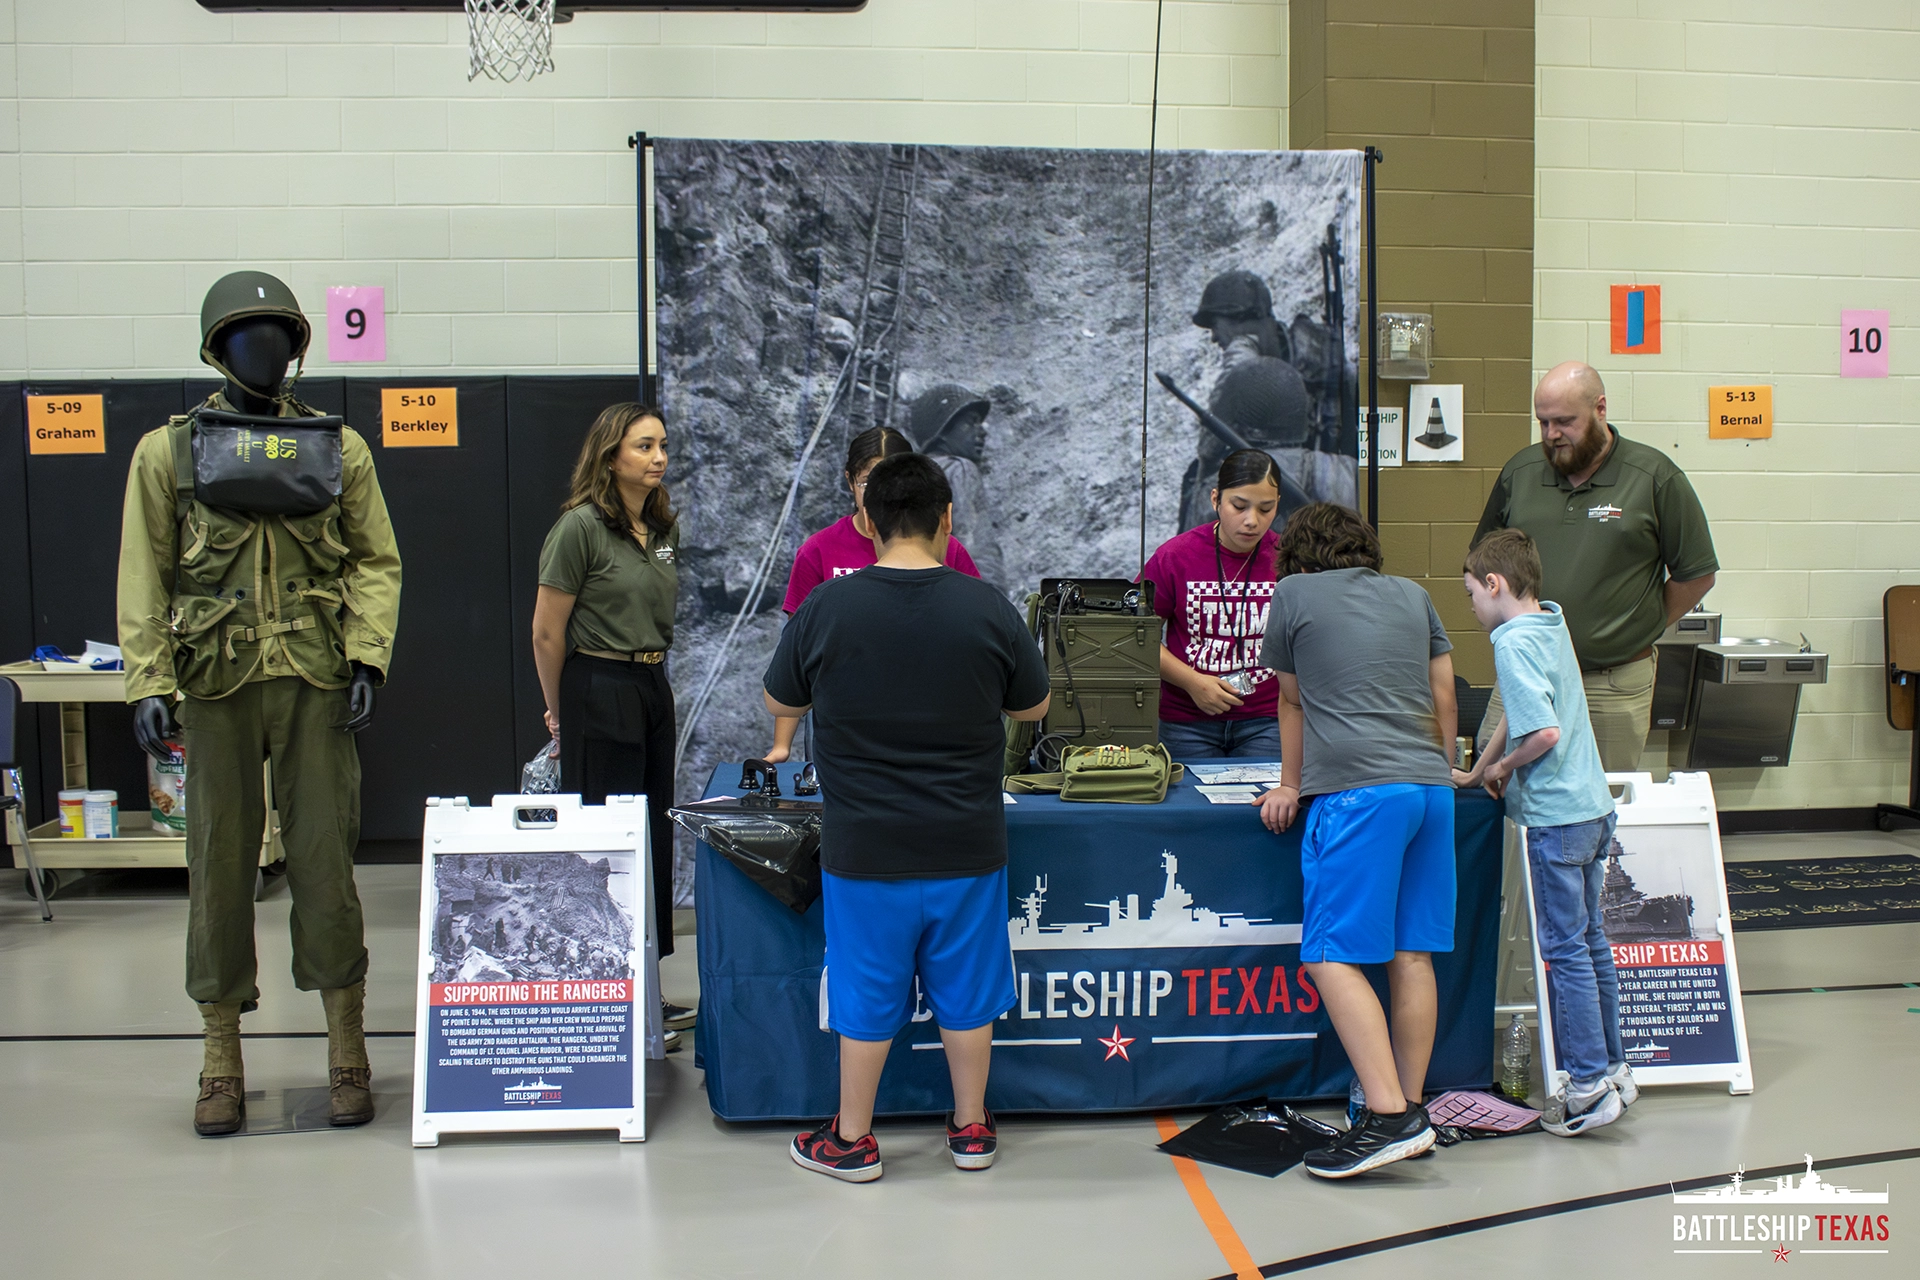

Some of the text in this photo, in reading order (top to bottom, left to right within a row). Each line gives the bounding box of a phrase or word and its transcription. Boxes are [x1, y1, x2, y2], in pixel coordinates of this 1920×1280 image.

[345, 308, 366, 339] 9
[1849, 328, 1882, 353] 10
[401, 395, 436, 406] 5-10
[1726, 392, 1756, 402] 5-13
[47, 402, 82, 414] 5-09
[1721, 414, 1762, 425] Bernal
[391, 420, 448, 434] Berkley
[36, 428, 96, 439] Graham
[280, 438, 297, 459] US
[1203, 602, 1270, 637] TEAM
[1660, 944, 1708, 963] TEXAS
[1639, 969, 1676, 978] BATTLESHIP
[1678, 968, 1698, 976] TEXAS
[1700, 968, 1711, 976] LED
[1643, 981, 1668, 989] CAREER
[1670, 980, 1677, 988] IN
[1679, 980, 1691, 988] THE
[1693, 979, 1716, 988] UNITED
[443, 982, 626, 1003] SUPPORTING THE RANGERS
[1181, 966, 1319, 1016] TEXAS
[1653, 992, 1666, 1001] SHE
[1668, 991, 1692, 1000] FOUGHT
[1694, 991, 1700, 999] IN
[1703, 990, 1720, 999] BOTH
[440, 1009, 449, 1017] ON
[571, 1006, 591, 1014] ARRIVE
[1633, 1004, 1662, 1013] SEVERAL
[1697, 1003, 1710, 1011] AND
[1712, 1002, 1726, 1010] WAS
[526, 1017, 539, 1025] SHIP
[1627, 1016, 1666, 1025] THOUSANDS
[1667, 1016, 1675, 1024] OF
[1677, 1015, 1704, 1023] SAILORS
[1706, 1014, 1719, 1022] AND
[559, 1026, 575, 1034] PRIOR
[595, 1025, 617, 1033] ARRIVAL
[1639, 1028, 1650, 1037] ALL
[1652, 1027, 1674, 1036] WALKS
[1676, 1027, 1684, 1035] OF
[1686, 1026, 1702, 1035] LIFE.
[582, 1045, 602, 1053] TASKED
[463, 1058, 473, 1066] THE
[502, 1057, 525, 1065] DESTROY
[527, 1056, 536, 1064] THE
[538, 1056, 553, 1064] GUNS
[504, 1092, 561, 1100] BATTLESHIP TEXAS
[966, 1142, 985, 1153] NIKE
